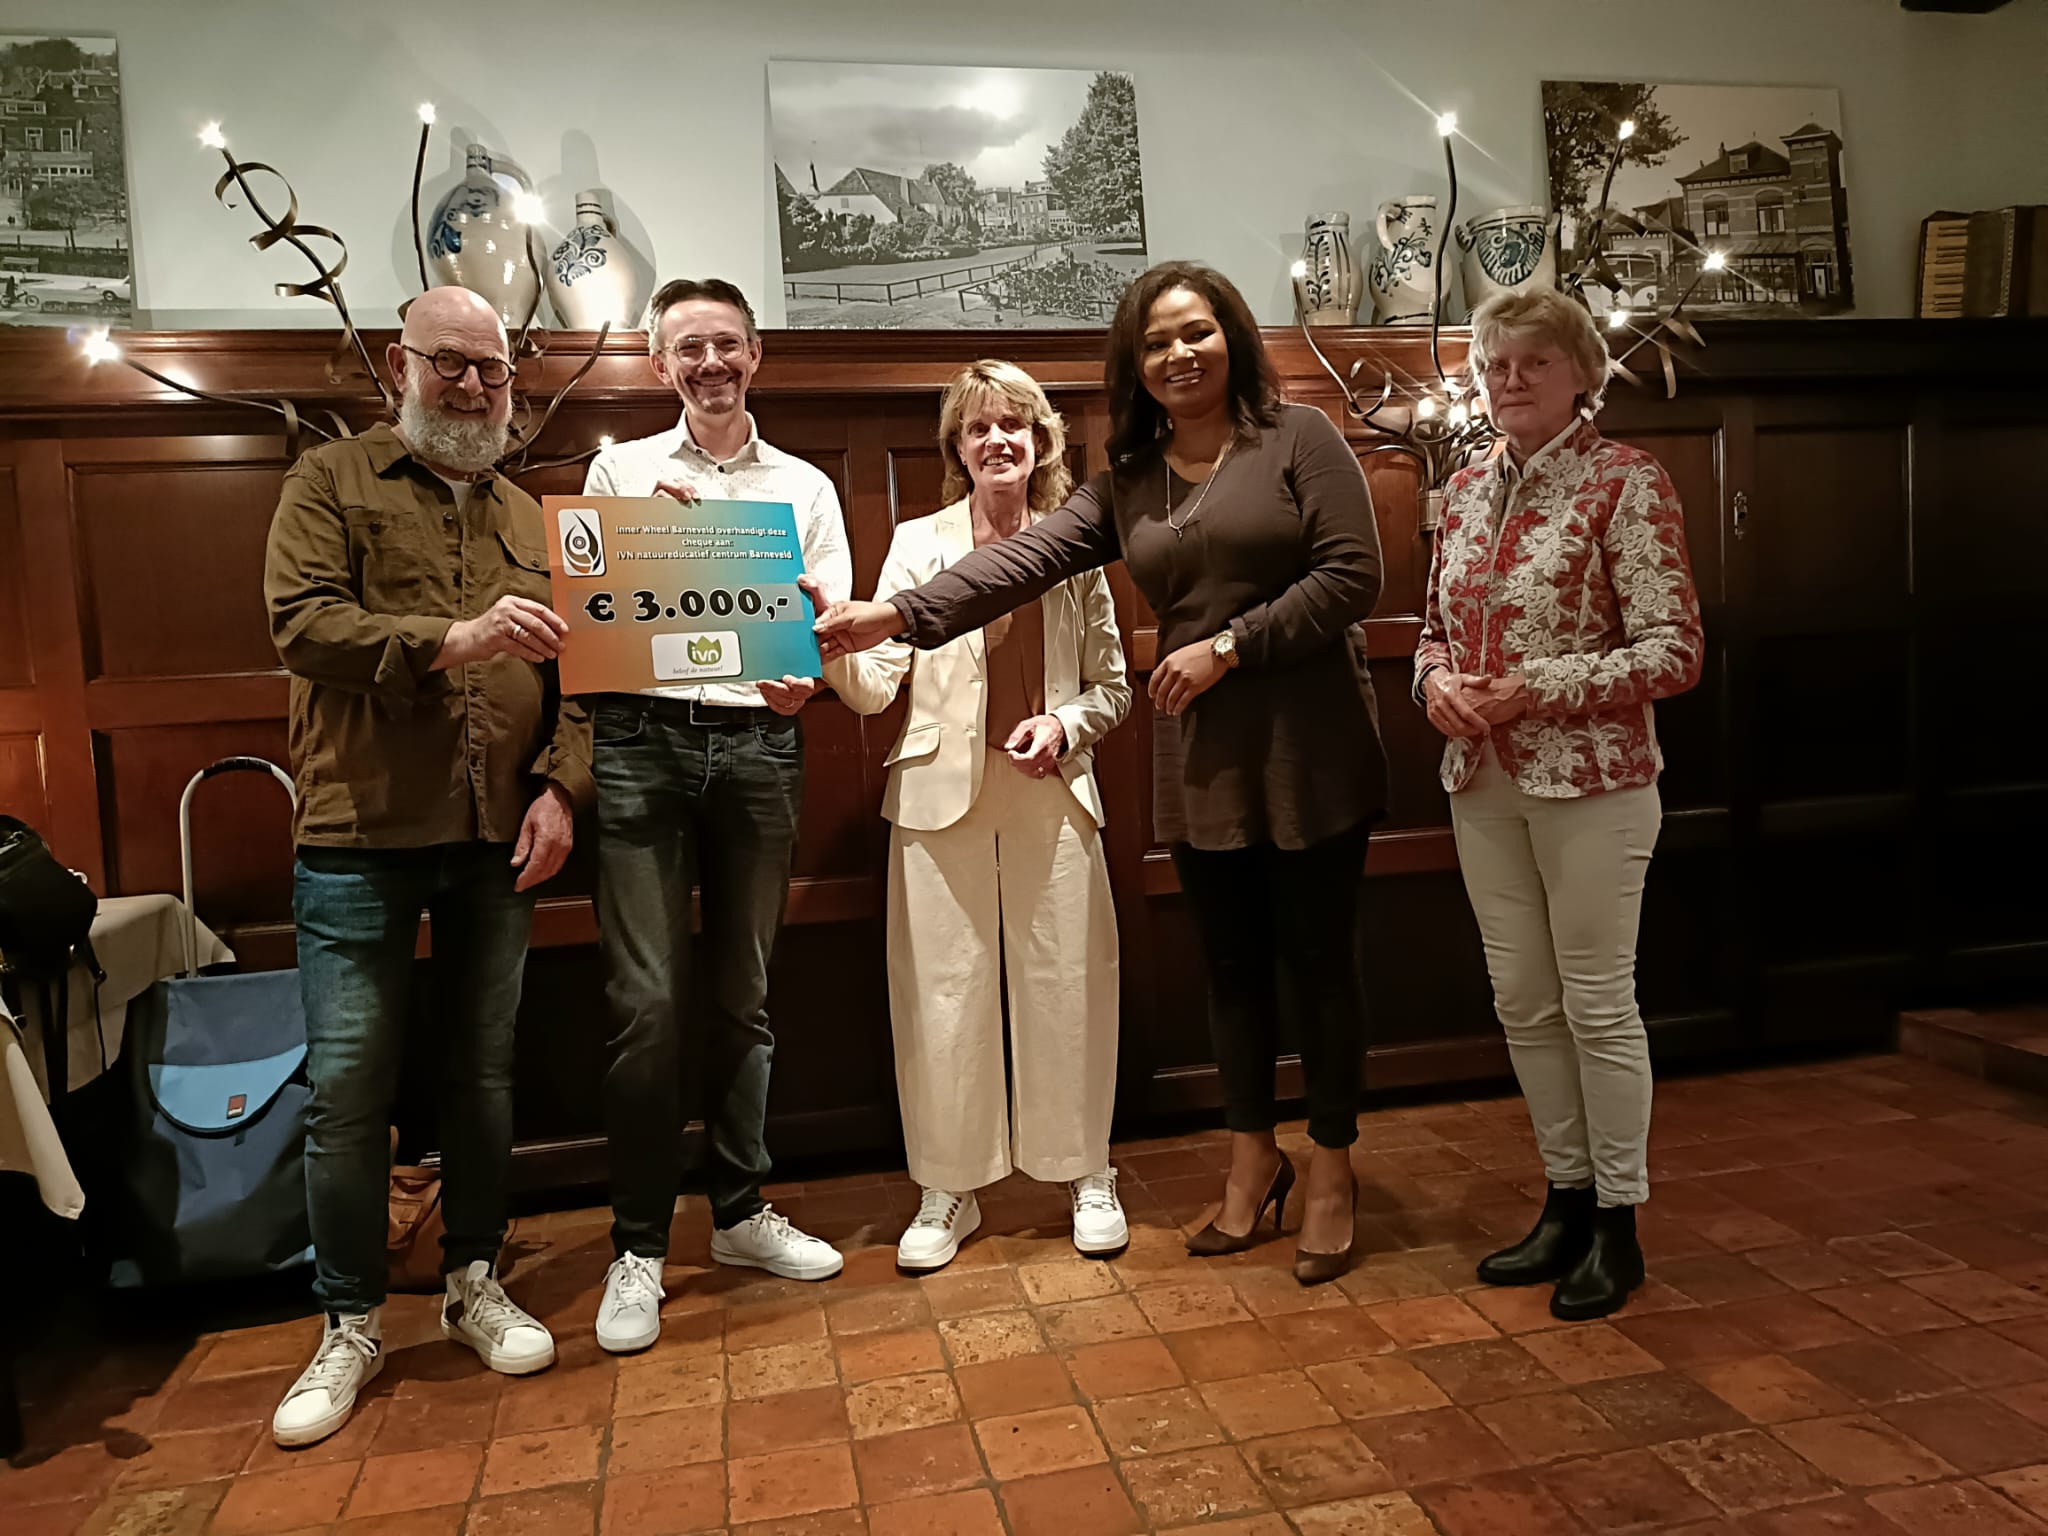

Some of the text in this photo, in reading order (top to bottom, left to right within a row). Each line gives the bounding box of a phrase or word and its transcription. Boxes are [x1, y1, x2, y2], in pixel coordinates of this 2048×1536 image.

[616, 526, 787, 537] Inner Wheel Barneveld overhandigt deze
[682, 539, 734, 548] cheque aan:
[616, 550, 793, 561] IVN natuureducatief centrum Barneveld
[584, 588, 789, 622] € 3.000,-
[691, 646, 720, 662] ivn
